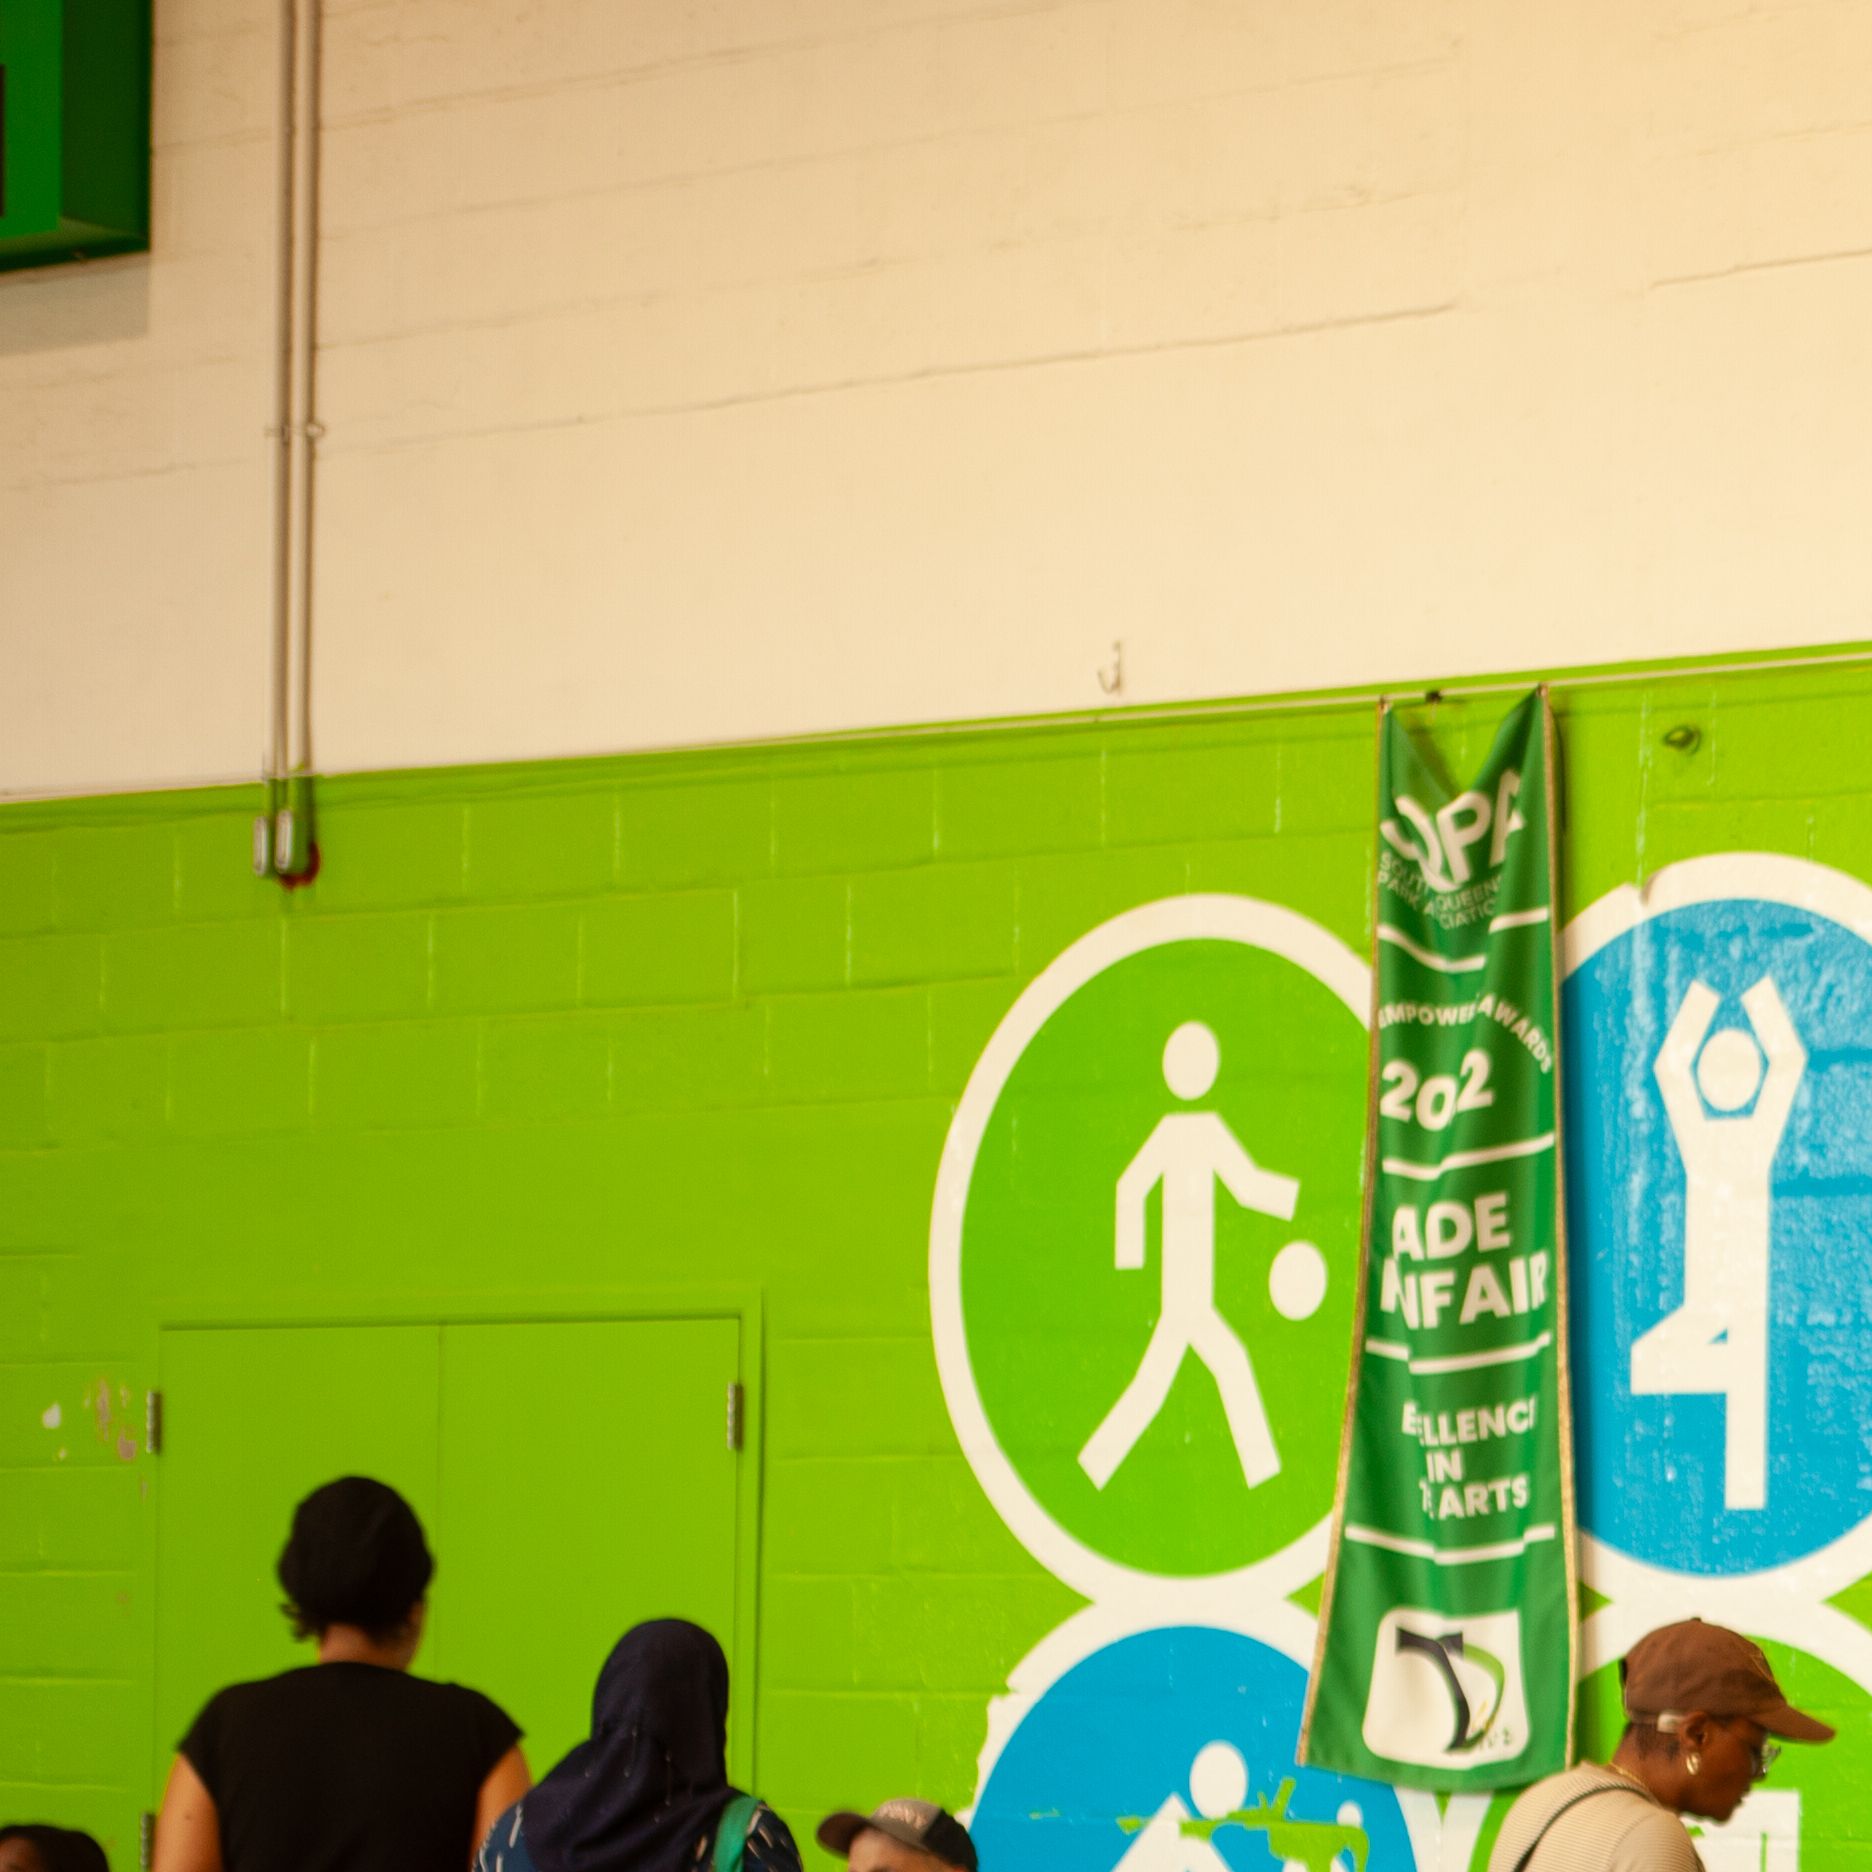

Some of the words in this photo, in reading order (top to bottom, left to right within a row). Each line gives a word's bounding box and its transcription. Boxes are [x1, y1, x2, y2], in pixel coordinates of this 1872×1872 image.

[1380, 1048, 1494, 1132] 202
[1426, 1448, 1464, 1483] IN
[1438, 1474, 1529, 1521] ARTS
